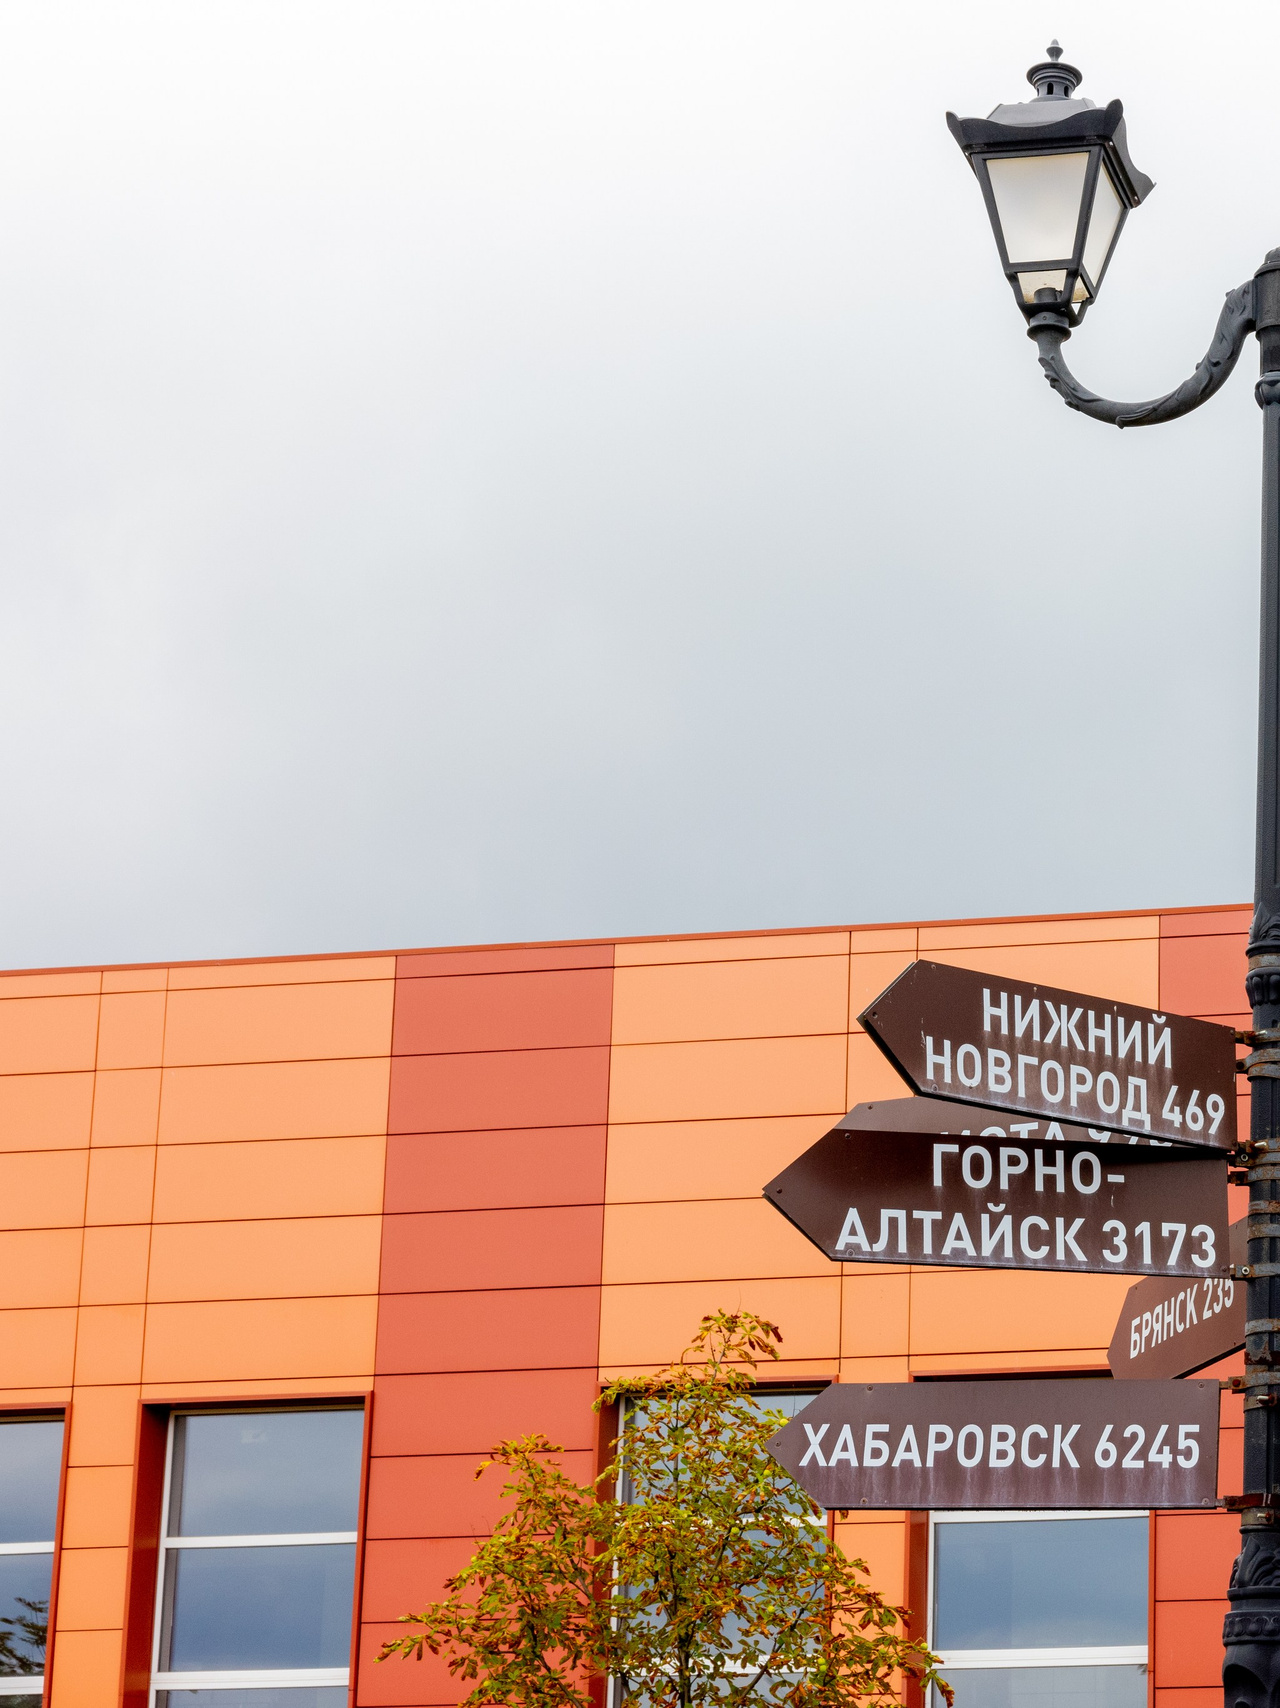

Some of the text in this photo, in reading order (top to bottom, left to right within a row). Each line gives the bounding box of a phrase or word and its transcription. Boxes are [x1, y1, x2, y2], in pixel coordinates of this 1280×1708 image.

[982, 987, 1173, 1069] НИЖНИЙ
[925, 1035, 1226, 1135] НОВГОРОД 469
[933, 1143, 1125, 1195] ГОРНО-
[834, 1202, 1217, 1268] АЛТАЙСК 3173
[1129, 1278, 1234, 1359] БРЯНСК 235
[798, 1423, 1200, 1469] ХАБАРОВСК 6245
